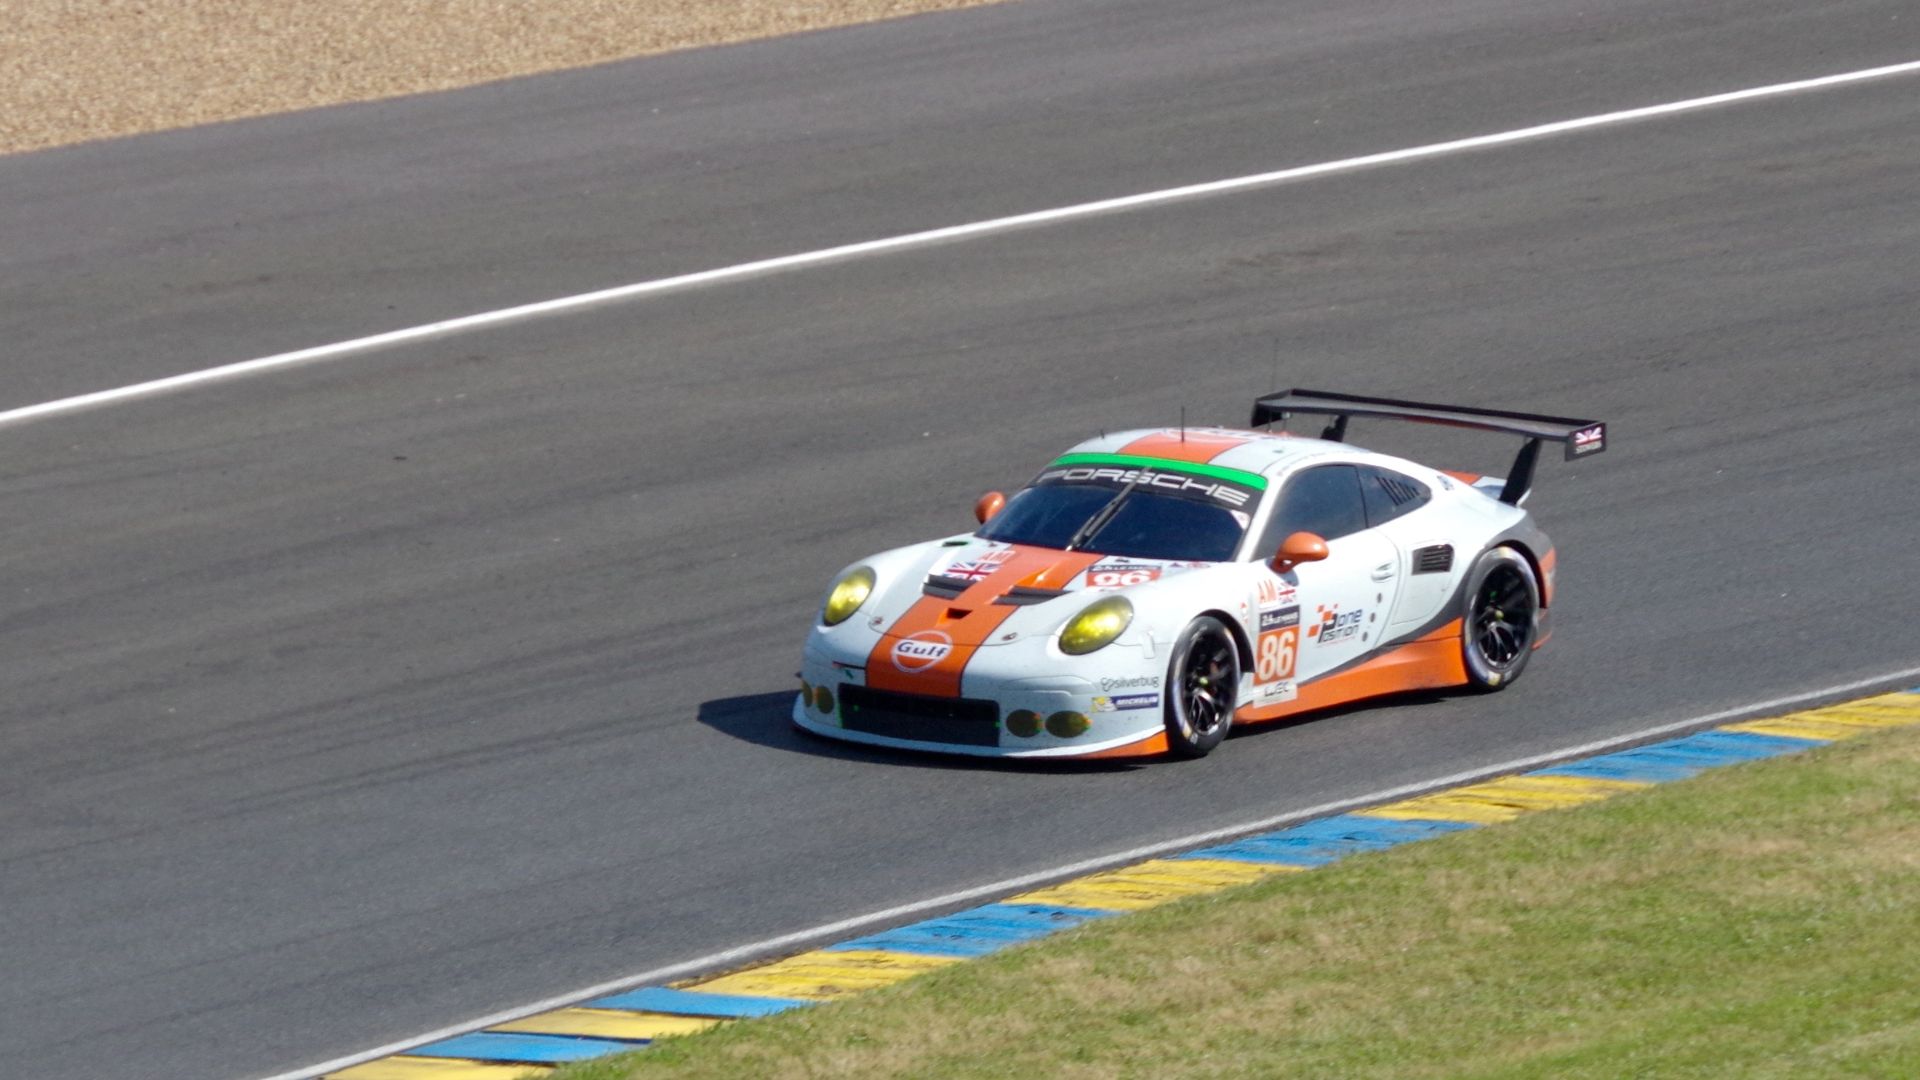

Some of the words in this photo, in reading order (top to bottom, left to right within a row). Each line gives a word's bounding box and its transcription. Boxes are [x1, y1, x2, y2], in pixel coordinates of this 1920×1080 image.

[1036, 467, 1250, 506] PORSCHE
[896, 640, 948, 658] Gulf
[1258, 630, 1295, 681] 86
[1115, 675, 1160, 689] silverbug
